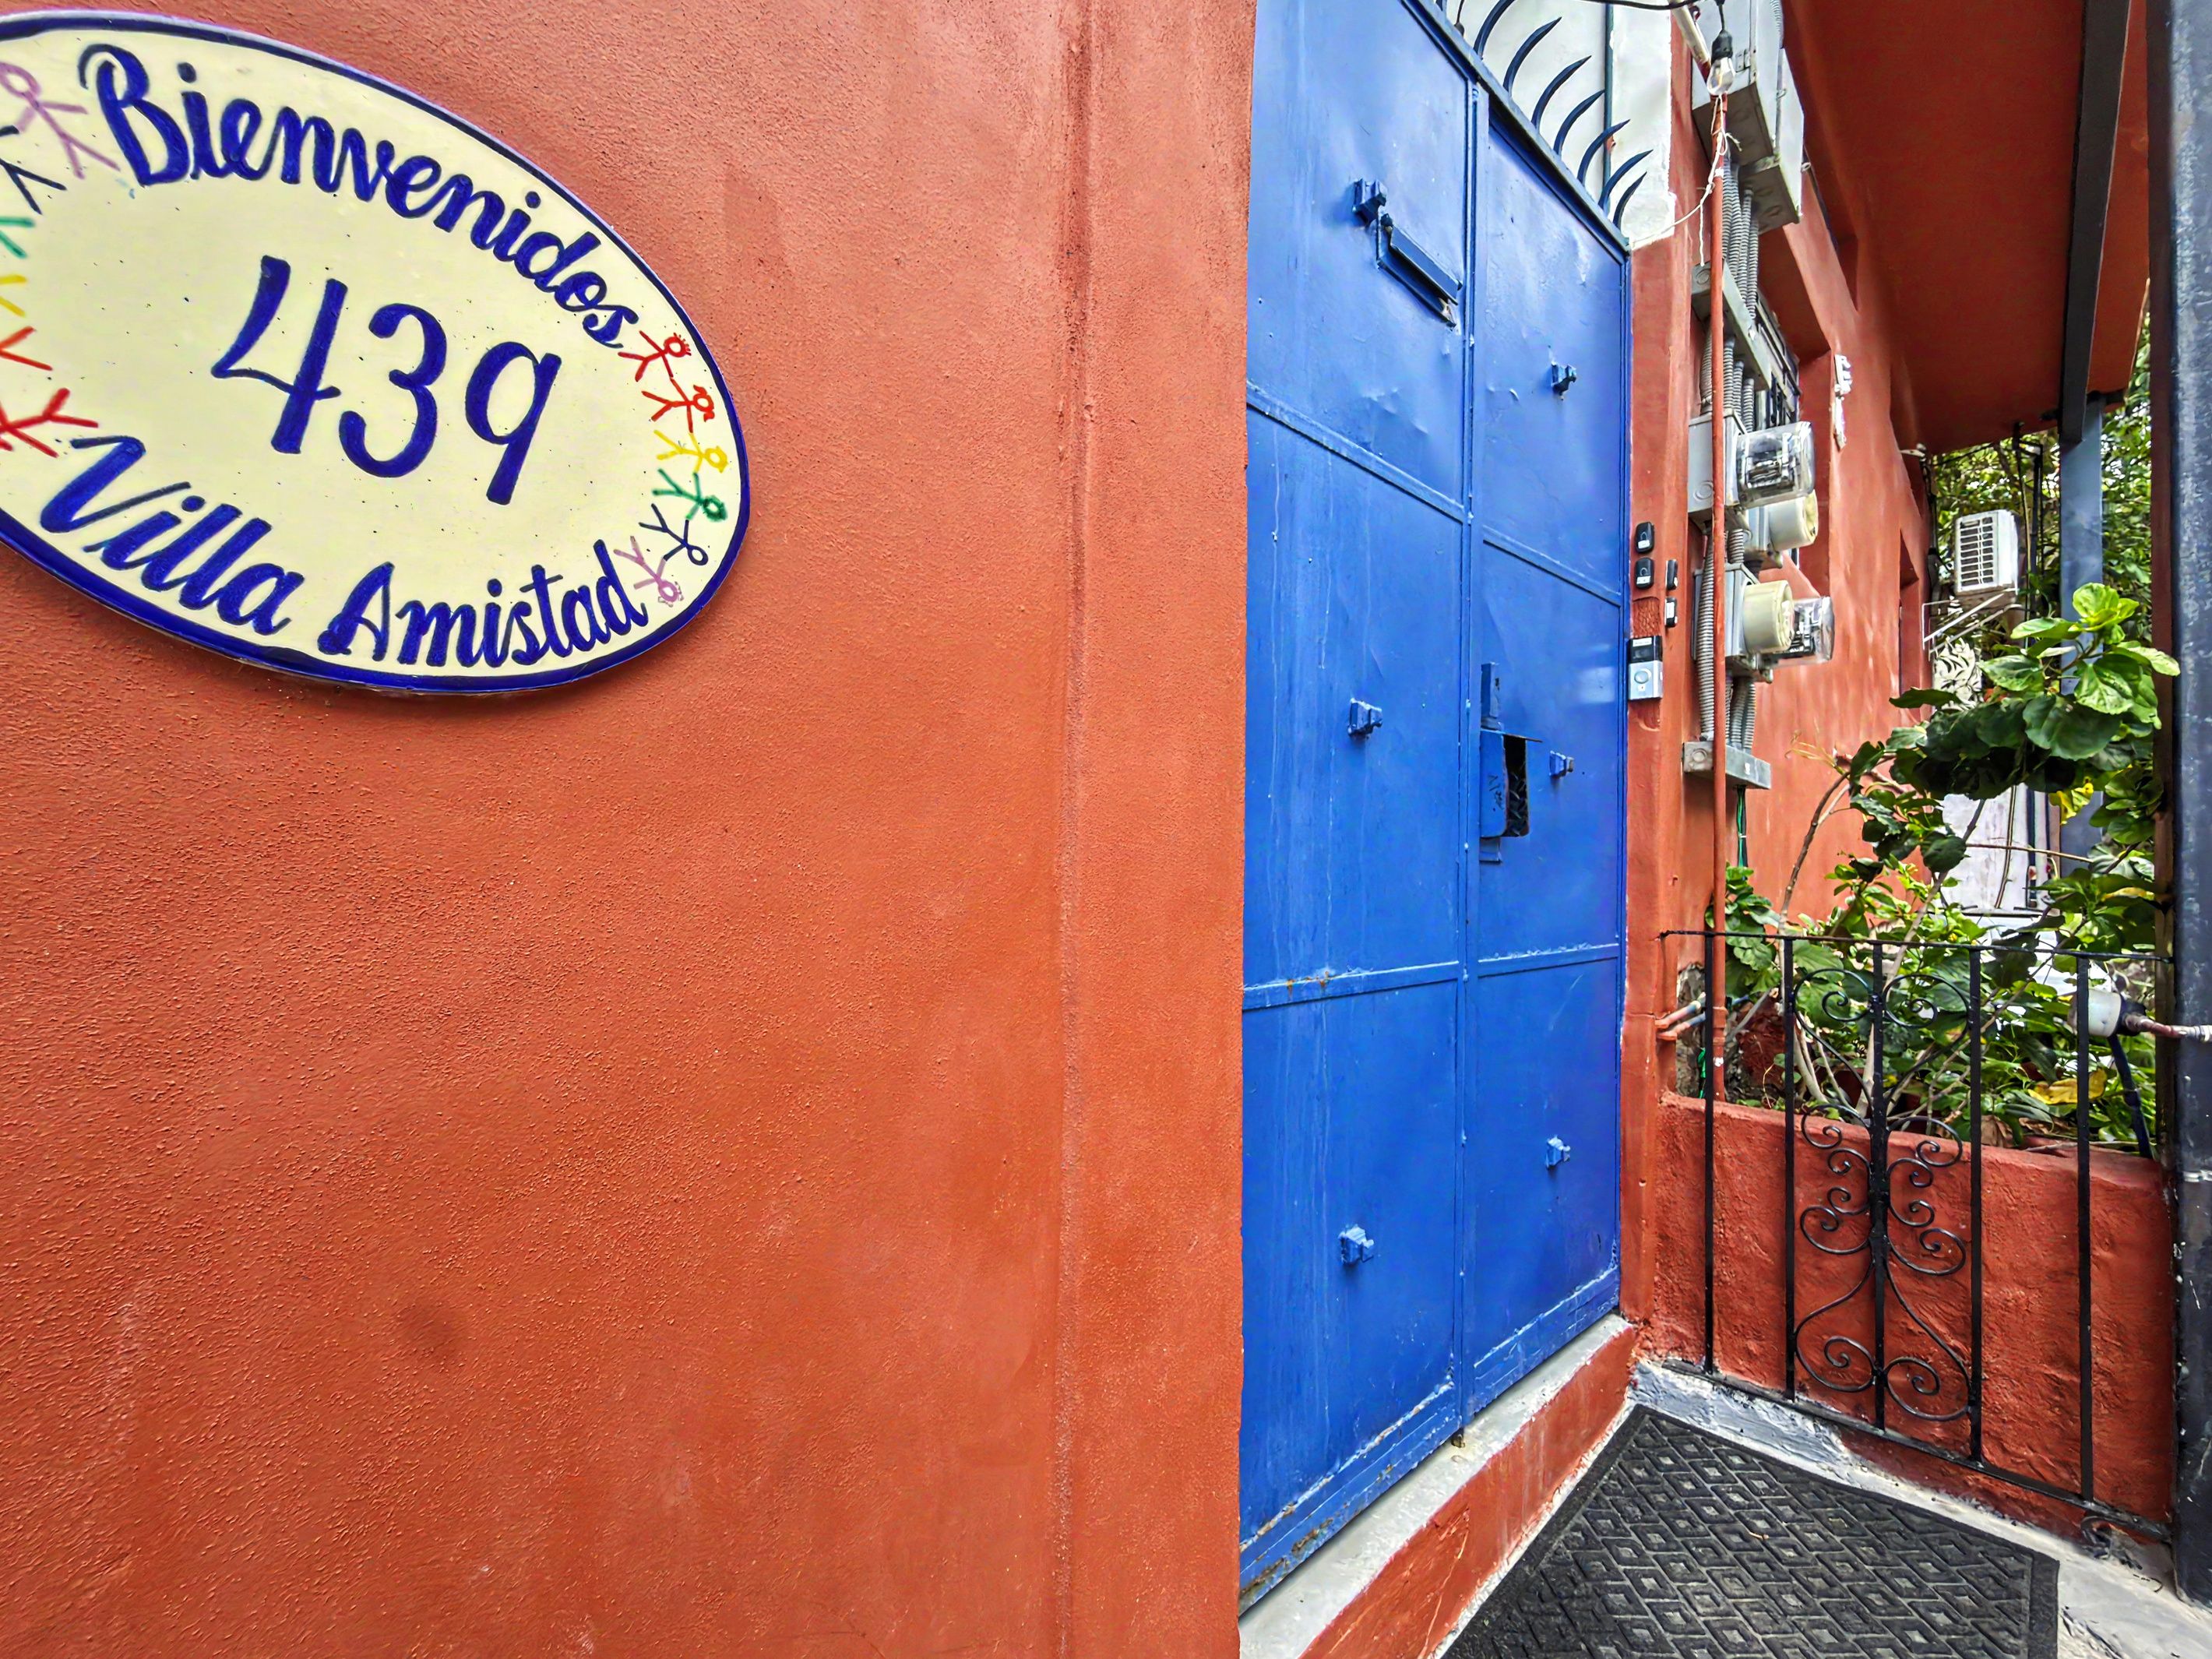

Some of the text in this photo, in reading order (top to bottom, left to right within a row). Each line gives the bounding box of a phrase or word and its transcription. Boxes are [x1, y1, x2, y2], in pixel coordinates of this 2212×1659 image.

[79, 43, 639, 348] Bienvenidos
[211, 255, 562, 505] 439
[40, 435, 648, 667] Villa Amistad
